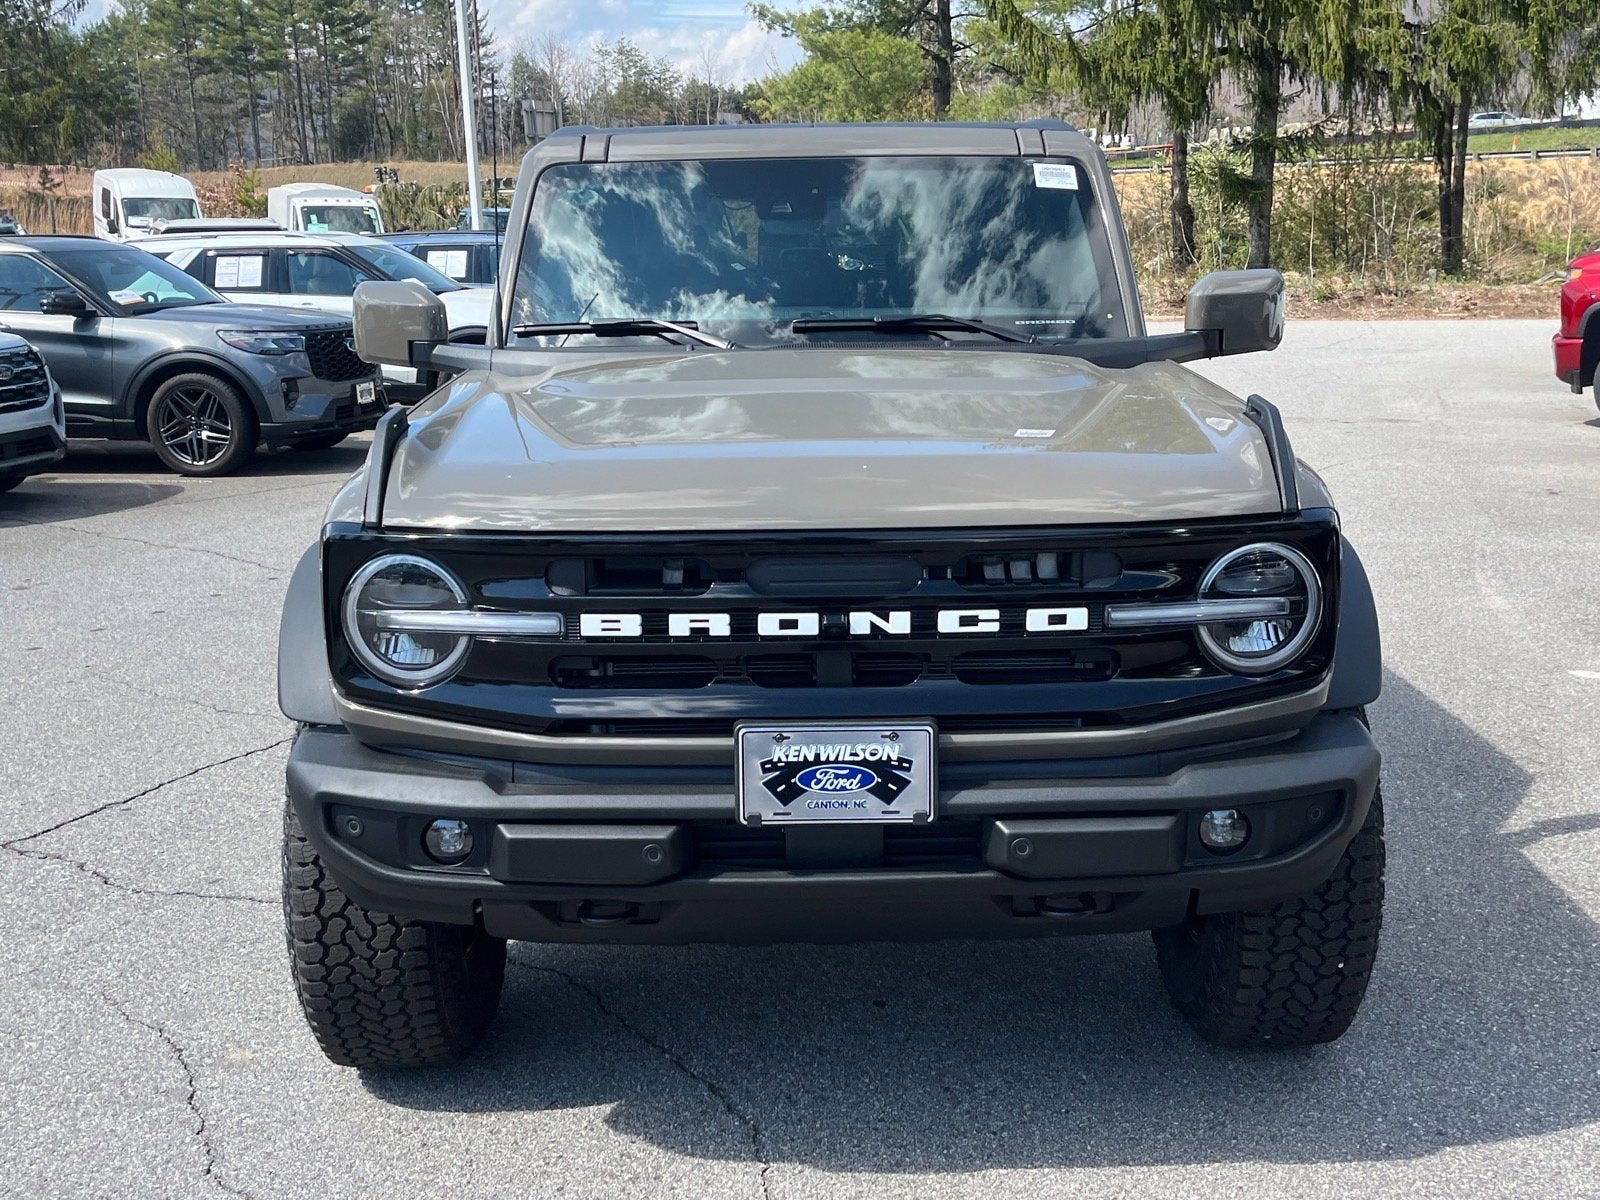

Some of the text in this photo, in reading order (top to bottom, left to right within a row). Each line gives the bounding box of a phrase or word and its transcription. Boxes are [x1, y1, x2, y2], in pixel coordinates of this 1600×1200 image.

[579, 607, 1089, 637] BRONCO
[772, 743, 902, 762] KEN WILSON
[810, 768, 863, 790] Ford
[806, 800, 867, 810] CANTON, NC
